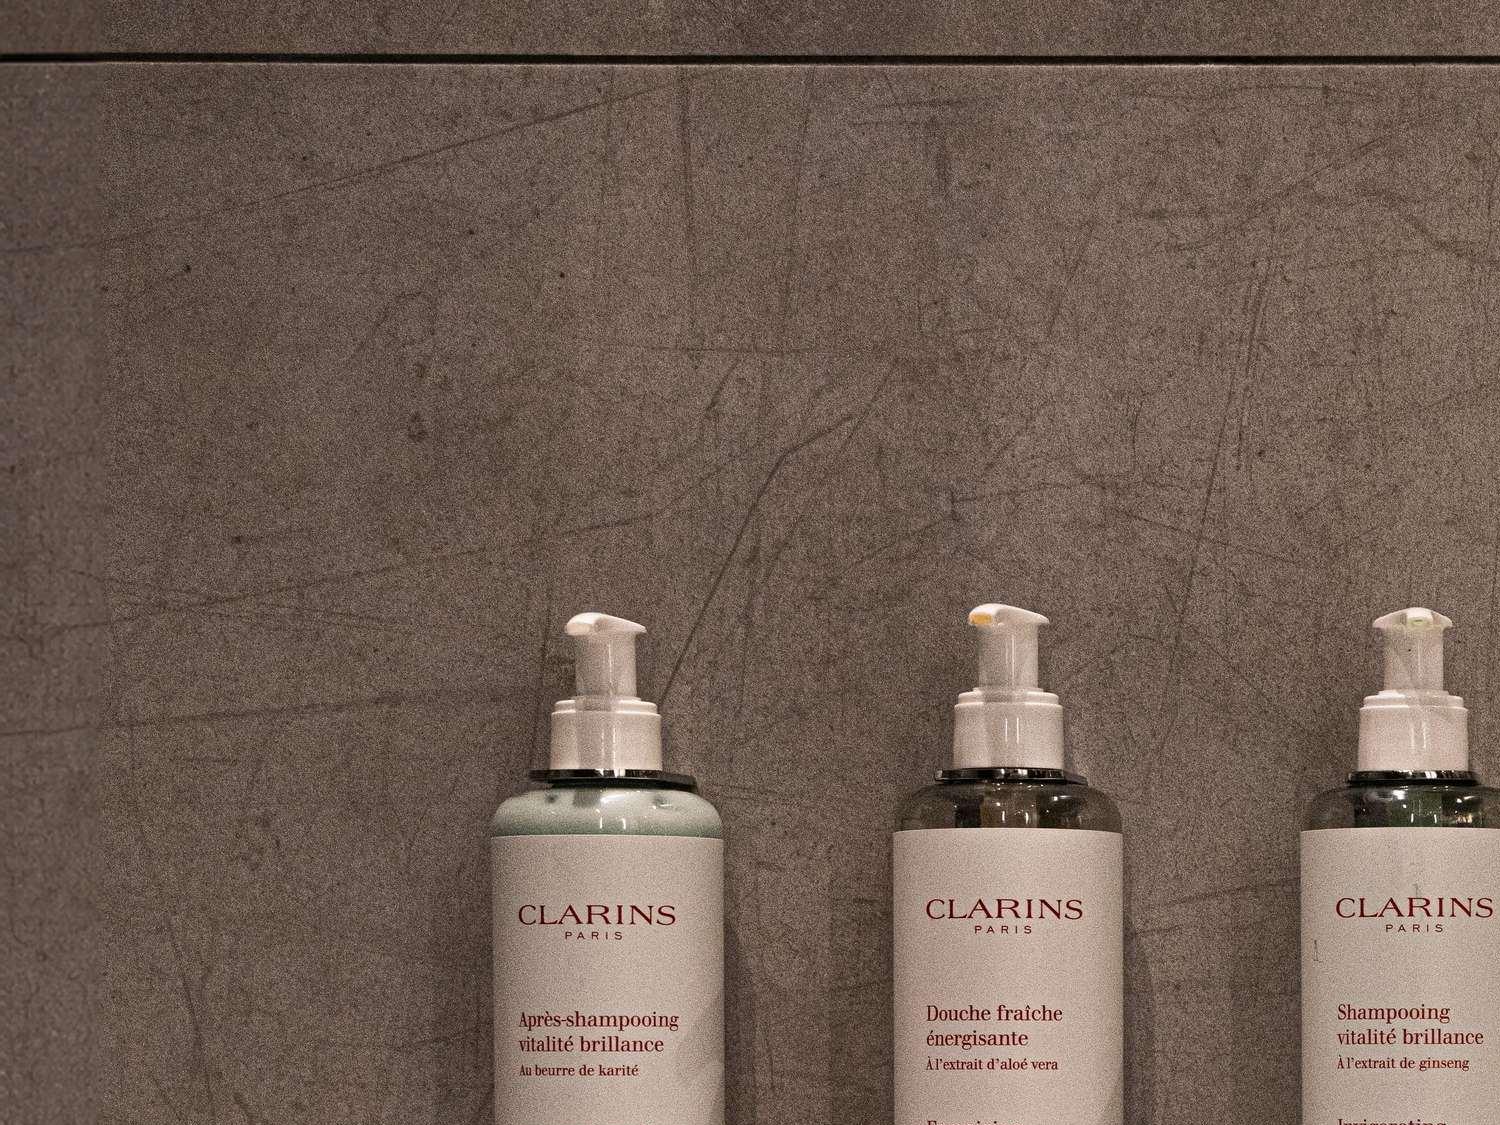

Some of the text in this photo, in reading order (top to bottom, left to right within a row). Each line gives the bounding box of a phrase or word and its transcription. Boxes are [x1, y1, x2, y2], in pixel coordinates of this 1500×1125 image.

[518, 904, 677, 926] CLARINS
[925, 898, 1084, 920] CLARINS
[1335, 897, 1494, 919] CLARINS
[564, 931, 624, 941] PARIS
[974, 925, 1033, 935] PARIS
[1385, 923, 1444, 933] PARIS
[519, 1011, 680, 1032] Après-shampooing
[926, 1004, 1063, 1022] Douche fraîche
[1337, 1003, 1451, 1024] Shampooing
[519, 1036, 665, 1053] vitalité brillance
[926, 1029, 1029, 1050] énergisante
[1337, 1028, 1484, 1045] vitalité brillance
[519, 1064, 640, 1077] Au beurre de karité
[1030, 1060, 1059, 1071] vera
[1399, 1056, 1416, 1069] de
[1419, 1056, 1470, 1072] ginseng
